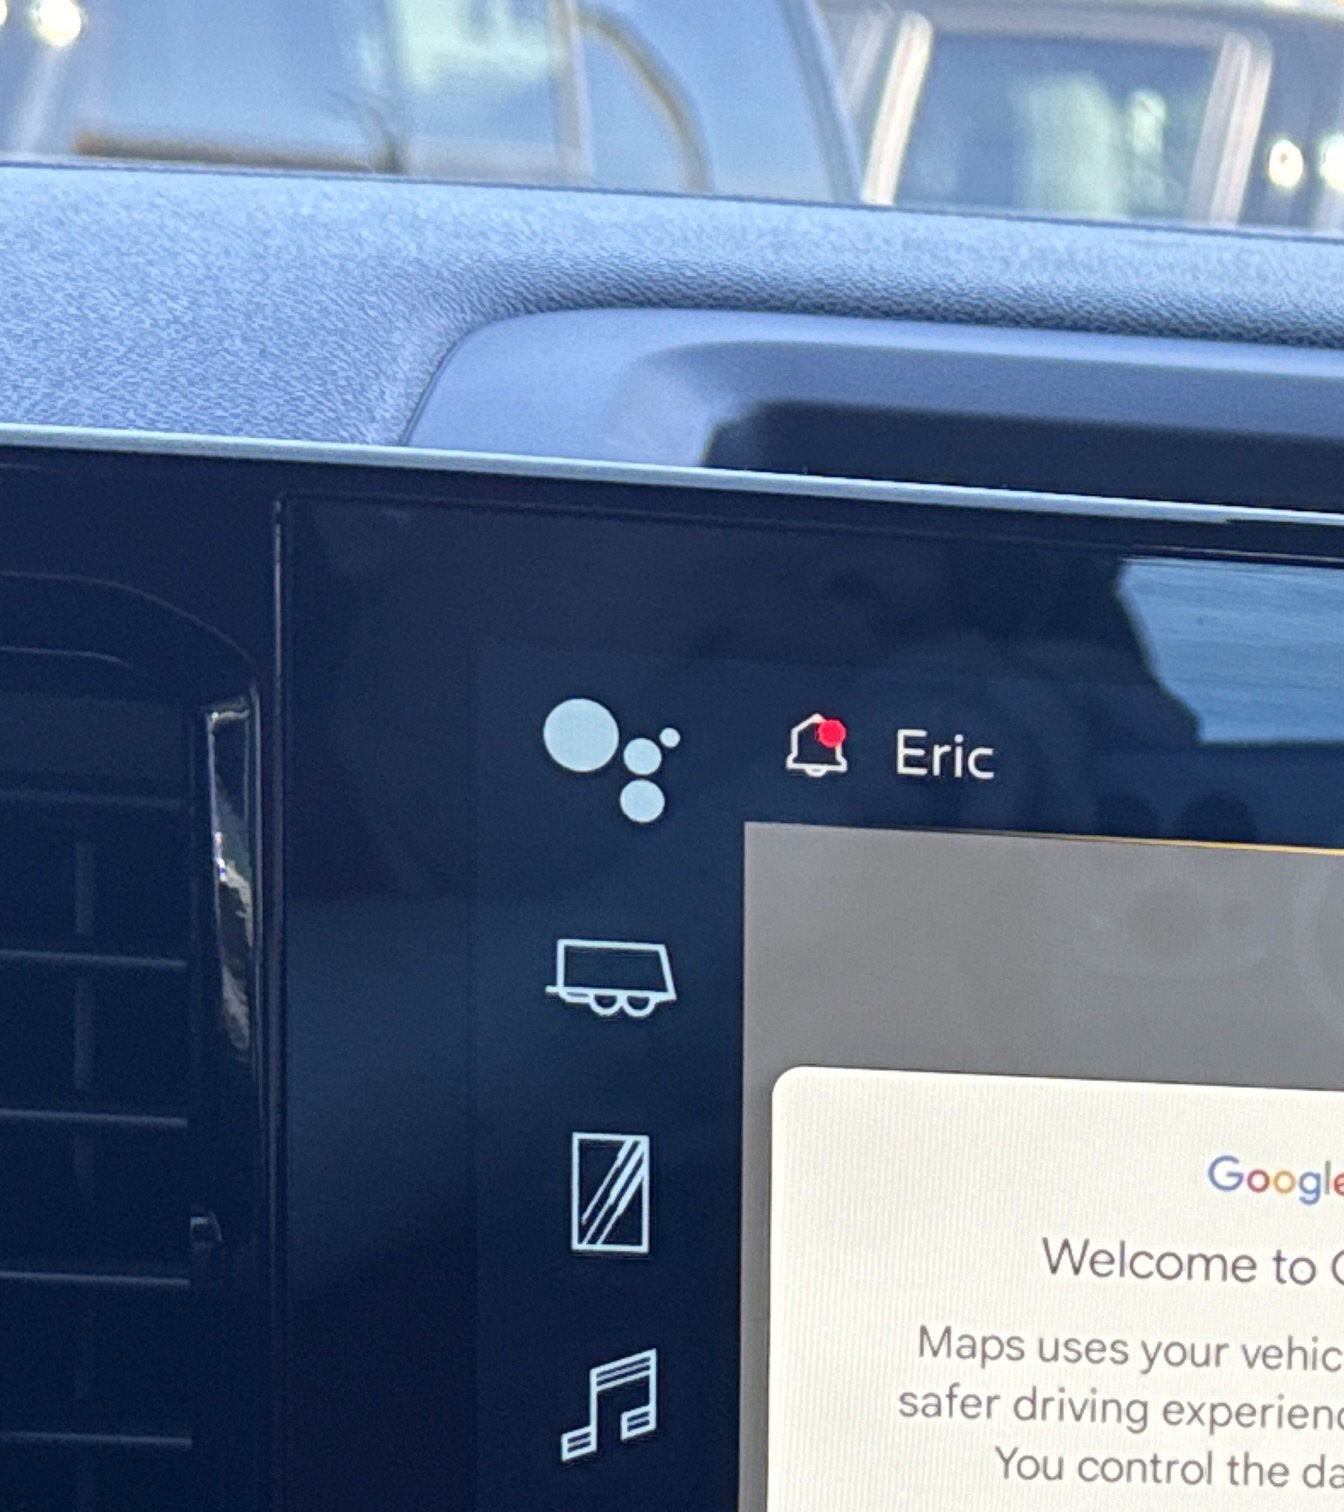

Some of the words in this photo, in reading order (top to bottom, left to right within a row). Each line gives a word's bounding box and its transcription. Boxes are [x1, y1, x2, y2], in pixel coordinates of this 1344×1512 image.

[896, 727, 995, 780] Eric
[1042, 1237, 1256, 1283] Welcome
[1273, 1250, 1316, 1285] to
[920, 1325, 1024, 1369] Maps
[1039, 1337, 1129, 1365] uses
[1141, 1341, 1229, 1374] your
[899, 1382, 1000, 1419] safer
[1014, 1386, 1148, 1434] driving
[995, 1446, 1063, 1480] You
[1078, 1451, 1212, 1485] control
[1227, 1452, 1289, 1487] the
